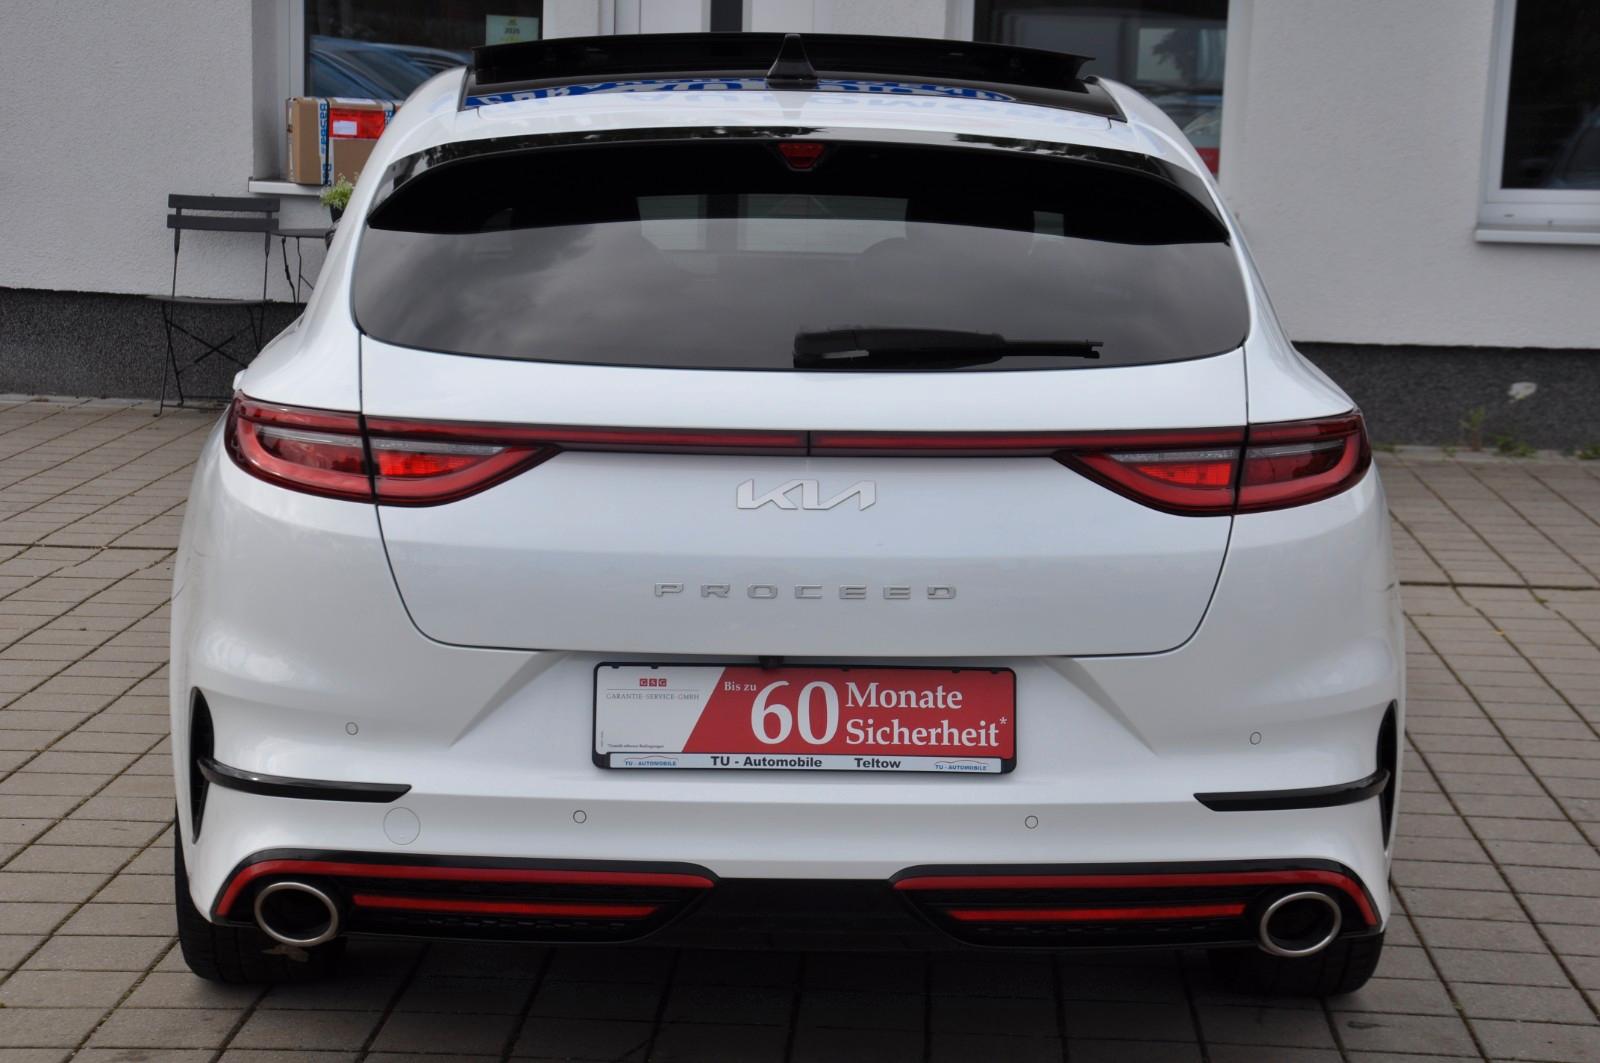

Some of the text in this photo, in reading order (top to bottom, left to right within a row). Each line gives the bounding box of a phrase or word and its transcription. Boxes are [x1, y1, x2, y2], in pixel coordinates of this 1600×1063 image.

[736, 479, 876, 511] KIA
[654, 582, 957, 600] PROCEED
[639, 678, 667, 687] GSG
[724, 681, 757, 692] Bis zu
[845, 682, 963, 709] Monate
[751, 680, 839, 745] 60
[710, 755, 730, 767] TU
[743, 756, 823, 768] Automobile
[854, 757, 901, 769] Teltow
